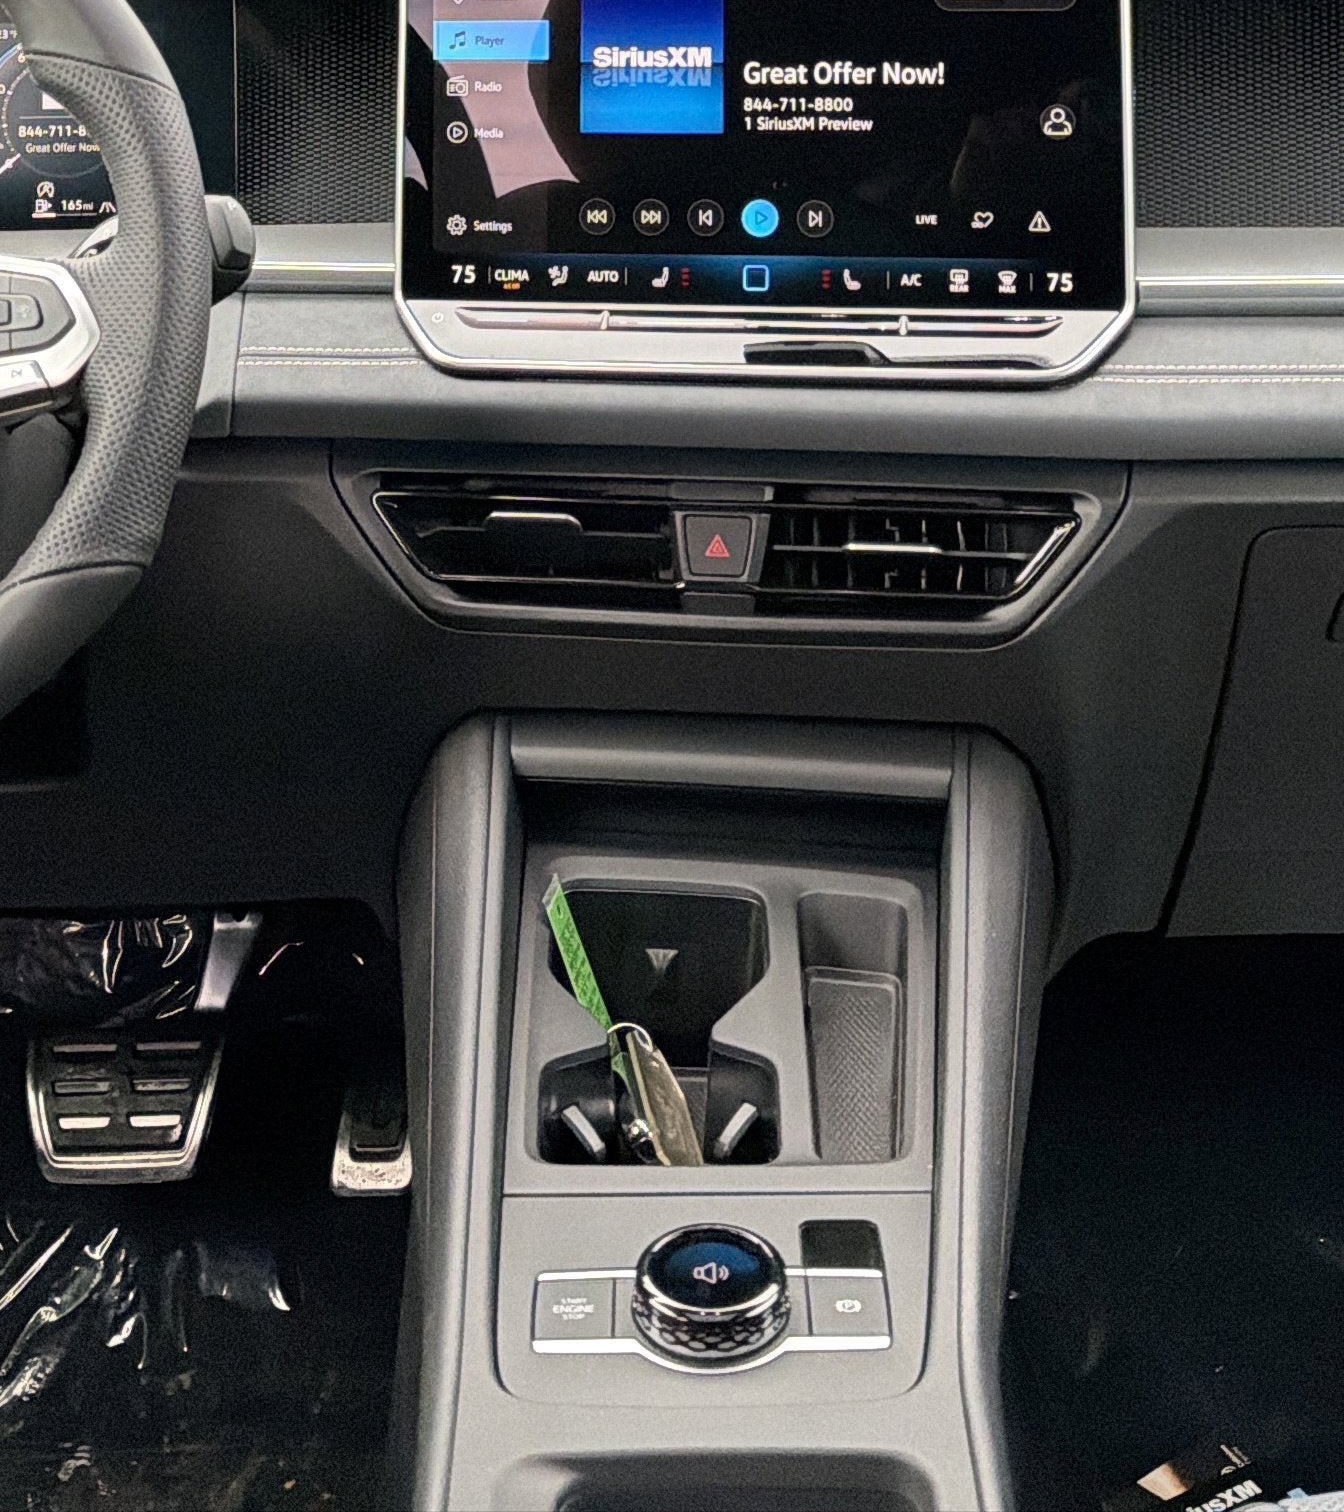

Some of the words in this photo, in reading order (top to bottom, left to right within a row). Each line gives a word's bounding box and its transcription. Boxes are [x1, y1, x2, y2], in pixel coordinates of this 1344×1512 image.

[475, 35, 504, 48] Player
[592, 46, 712, 68] SiriusXM
[743, 62, 808, 85] Great
[813, 61, 875, 85] Offer
[882, 62, 945, 85] Now!
[474, 81, 502, 92] Radio
[743, 96, 853, 112] 844-711-8800
[744, 118, 751, 131] 1
[756, 117, 814, 131] SiriusXM
[818, 117, 874, 131] Preview
[18, 125, 86, 137] 844-711-8
[474, 127, 504, 139] Media
[25, 143, 50, 153] Great
[53, 143, 76, 153] Offer
[915, 215, 938, 225] LIVE
[473, 220, 512, 234] Settings
[451, 265, 476, 283] 75
[494, 268, 530, 282] CLIMA
[587, 270, 619, 283] AUTO
[900, 274, 922, 287] A/C
[1046, 272, 1073, 292] 75
[552, 1305, 594, 1313] ENGINE
